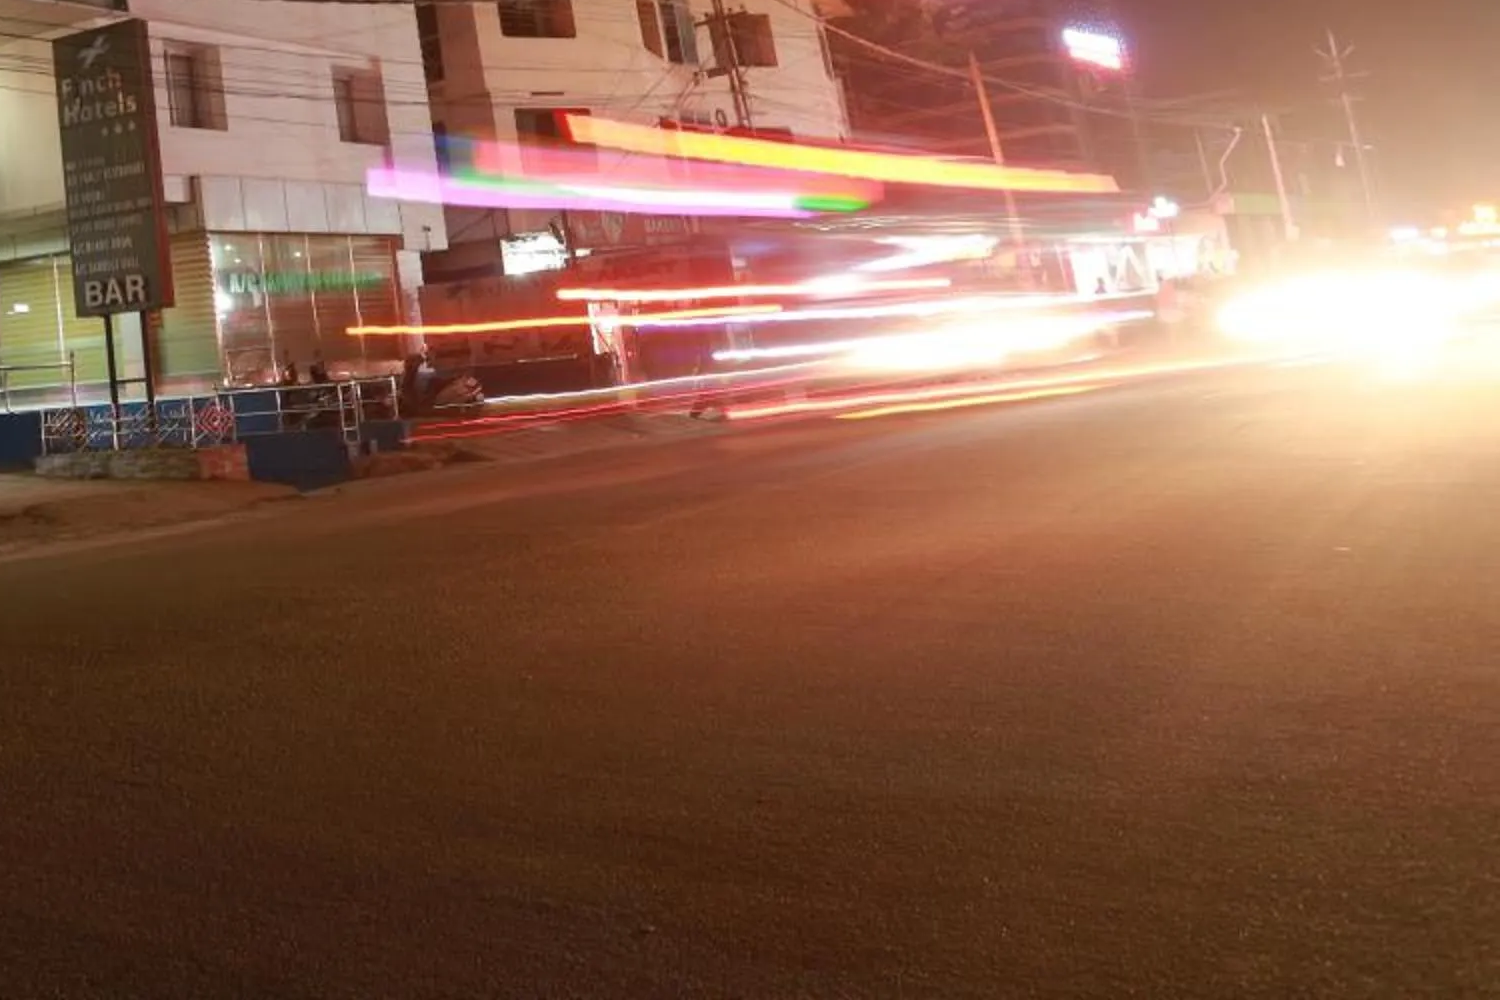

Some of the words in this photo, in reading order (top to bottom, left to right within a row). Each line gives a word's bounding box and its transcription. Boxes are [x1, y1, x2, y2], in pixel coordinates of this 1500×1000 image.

[61, 69, 121, 98] Fnch
[63, 90, 137, 127] Hotels
[84, 274, 146, 307] BAR
